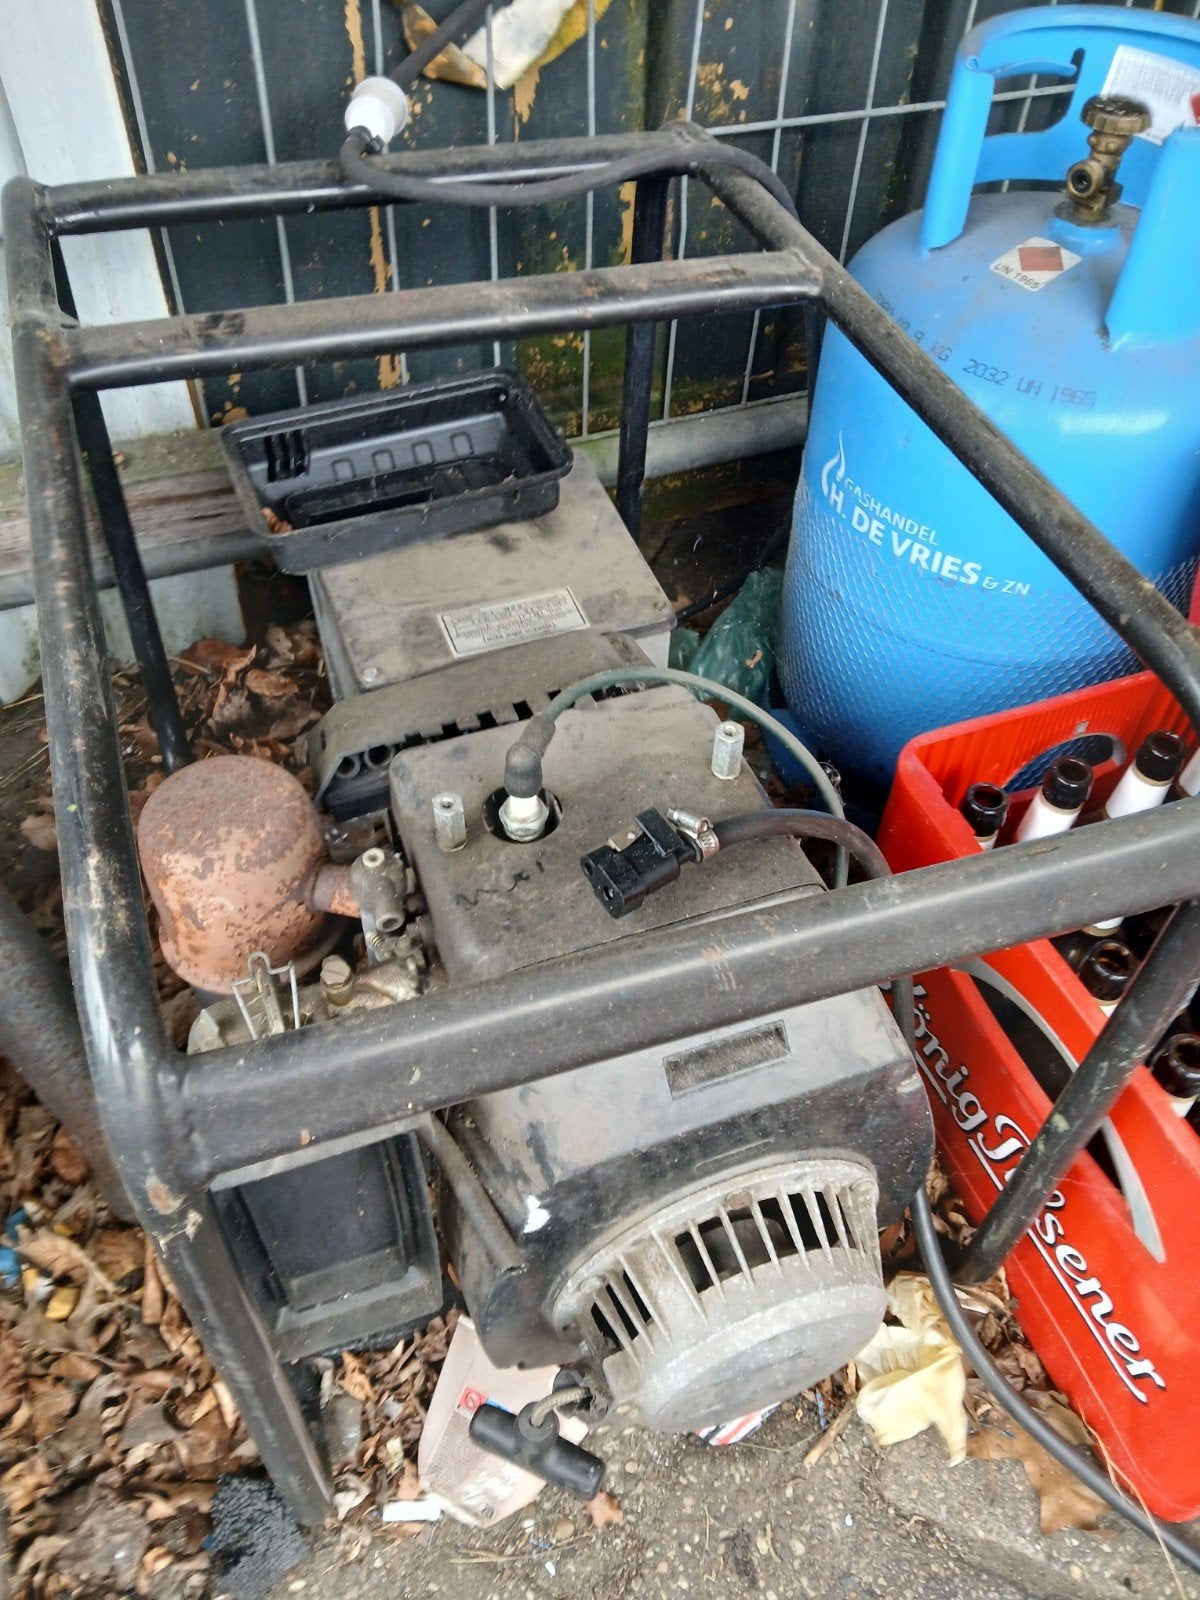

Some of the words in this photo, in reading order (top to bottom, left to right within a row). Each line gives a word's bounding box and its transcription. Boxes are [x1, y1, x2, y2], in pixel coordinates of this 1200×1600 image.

[962, 358, 1009, 386] 2032
[1016, 377, 1043, 396] UN
[851, 505, 886, 546] DE
[890, 528, 983, 586] VRIES
[982, 576, 999, 590] &
[1001, 579, 1031, 596] ZN
